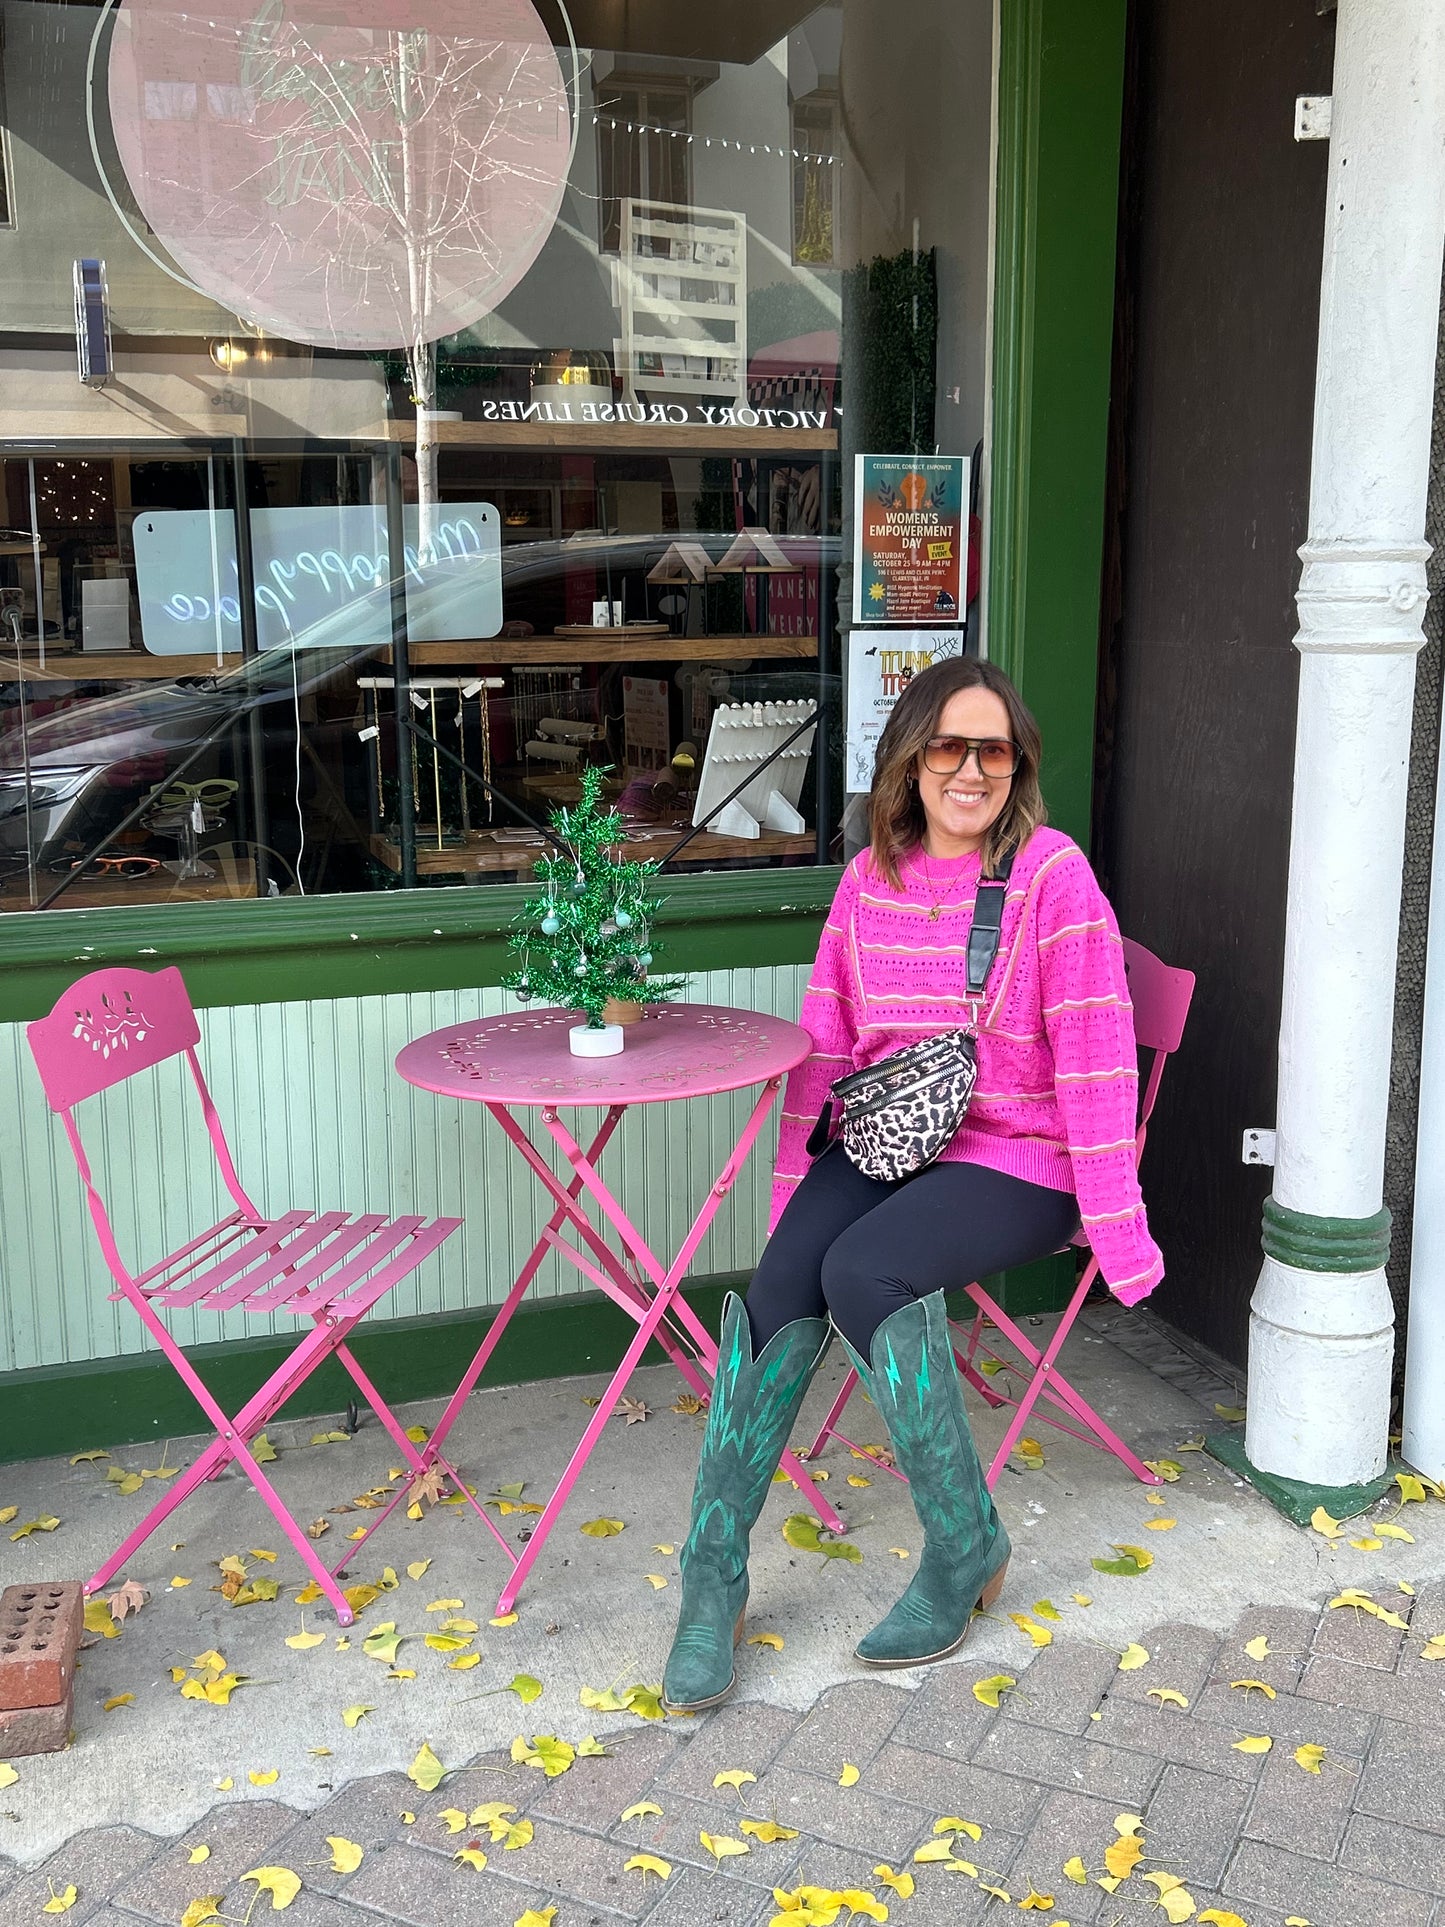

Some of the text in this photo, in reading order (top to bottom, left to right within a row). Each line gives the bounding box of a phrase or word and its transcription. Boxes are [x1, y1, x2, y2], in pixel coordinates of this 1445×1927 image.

[885, 512, 939, 525] WOMEN'S
[869, 525, 954, 537] EMPOWERMENT
[902, 537, 923, 549] DAY
[873, 552, 907, 560] SATURDAY,
[931, 550, 948, 558] EVENT
[873, 559, 902, 567] OCTOBER
[903, 559, 911, 567] 25
[921, 559, 932, 567] AM
[941, 560, 951, 568] PM
[768, 614, 814, 635] WELRY
